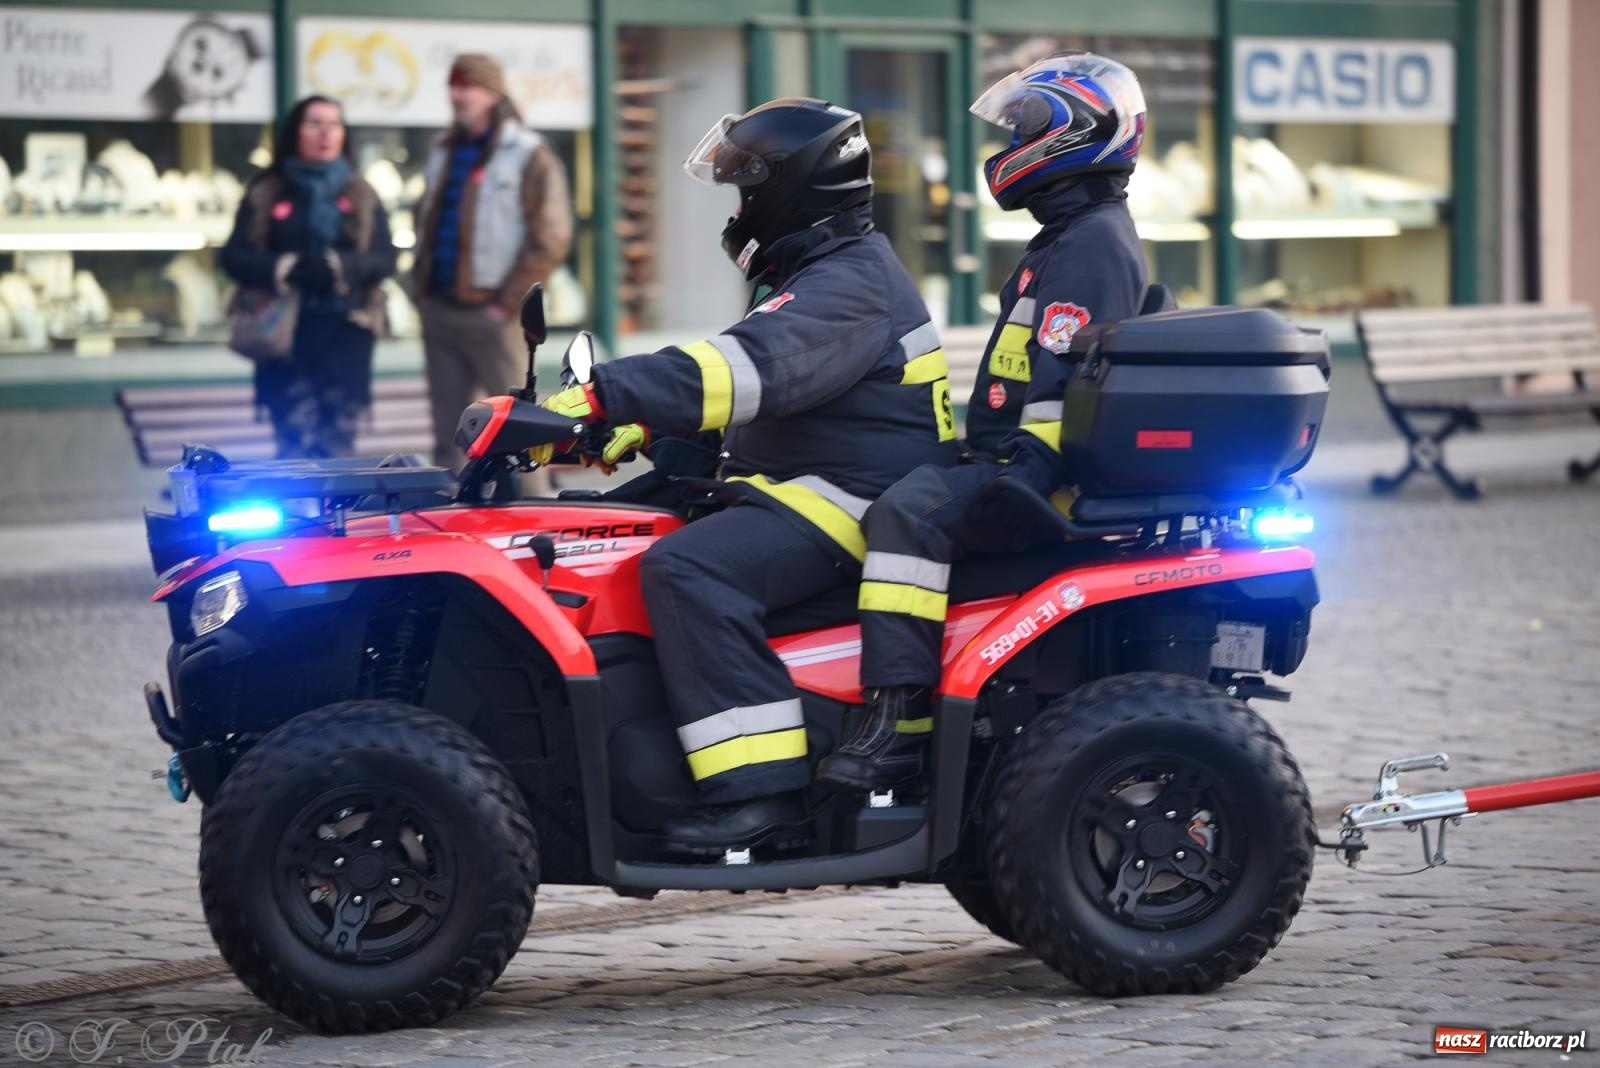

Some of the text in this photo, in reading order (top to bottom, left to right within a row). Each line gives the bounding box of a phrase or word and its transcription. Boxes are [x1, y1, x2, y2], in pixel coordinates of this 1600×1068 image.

[1245, 50, 1433, 108] CASIO
[611, 541, 627, 552] L
[1135, 563, 1222, 586] CFMOTO
